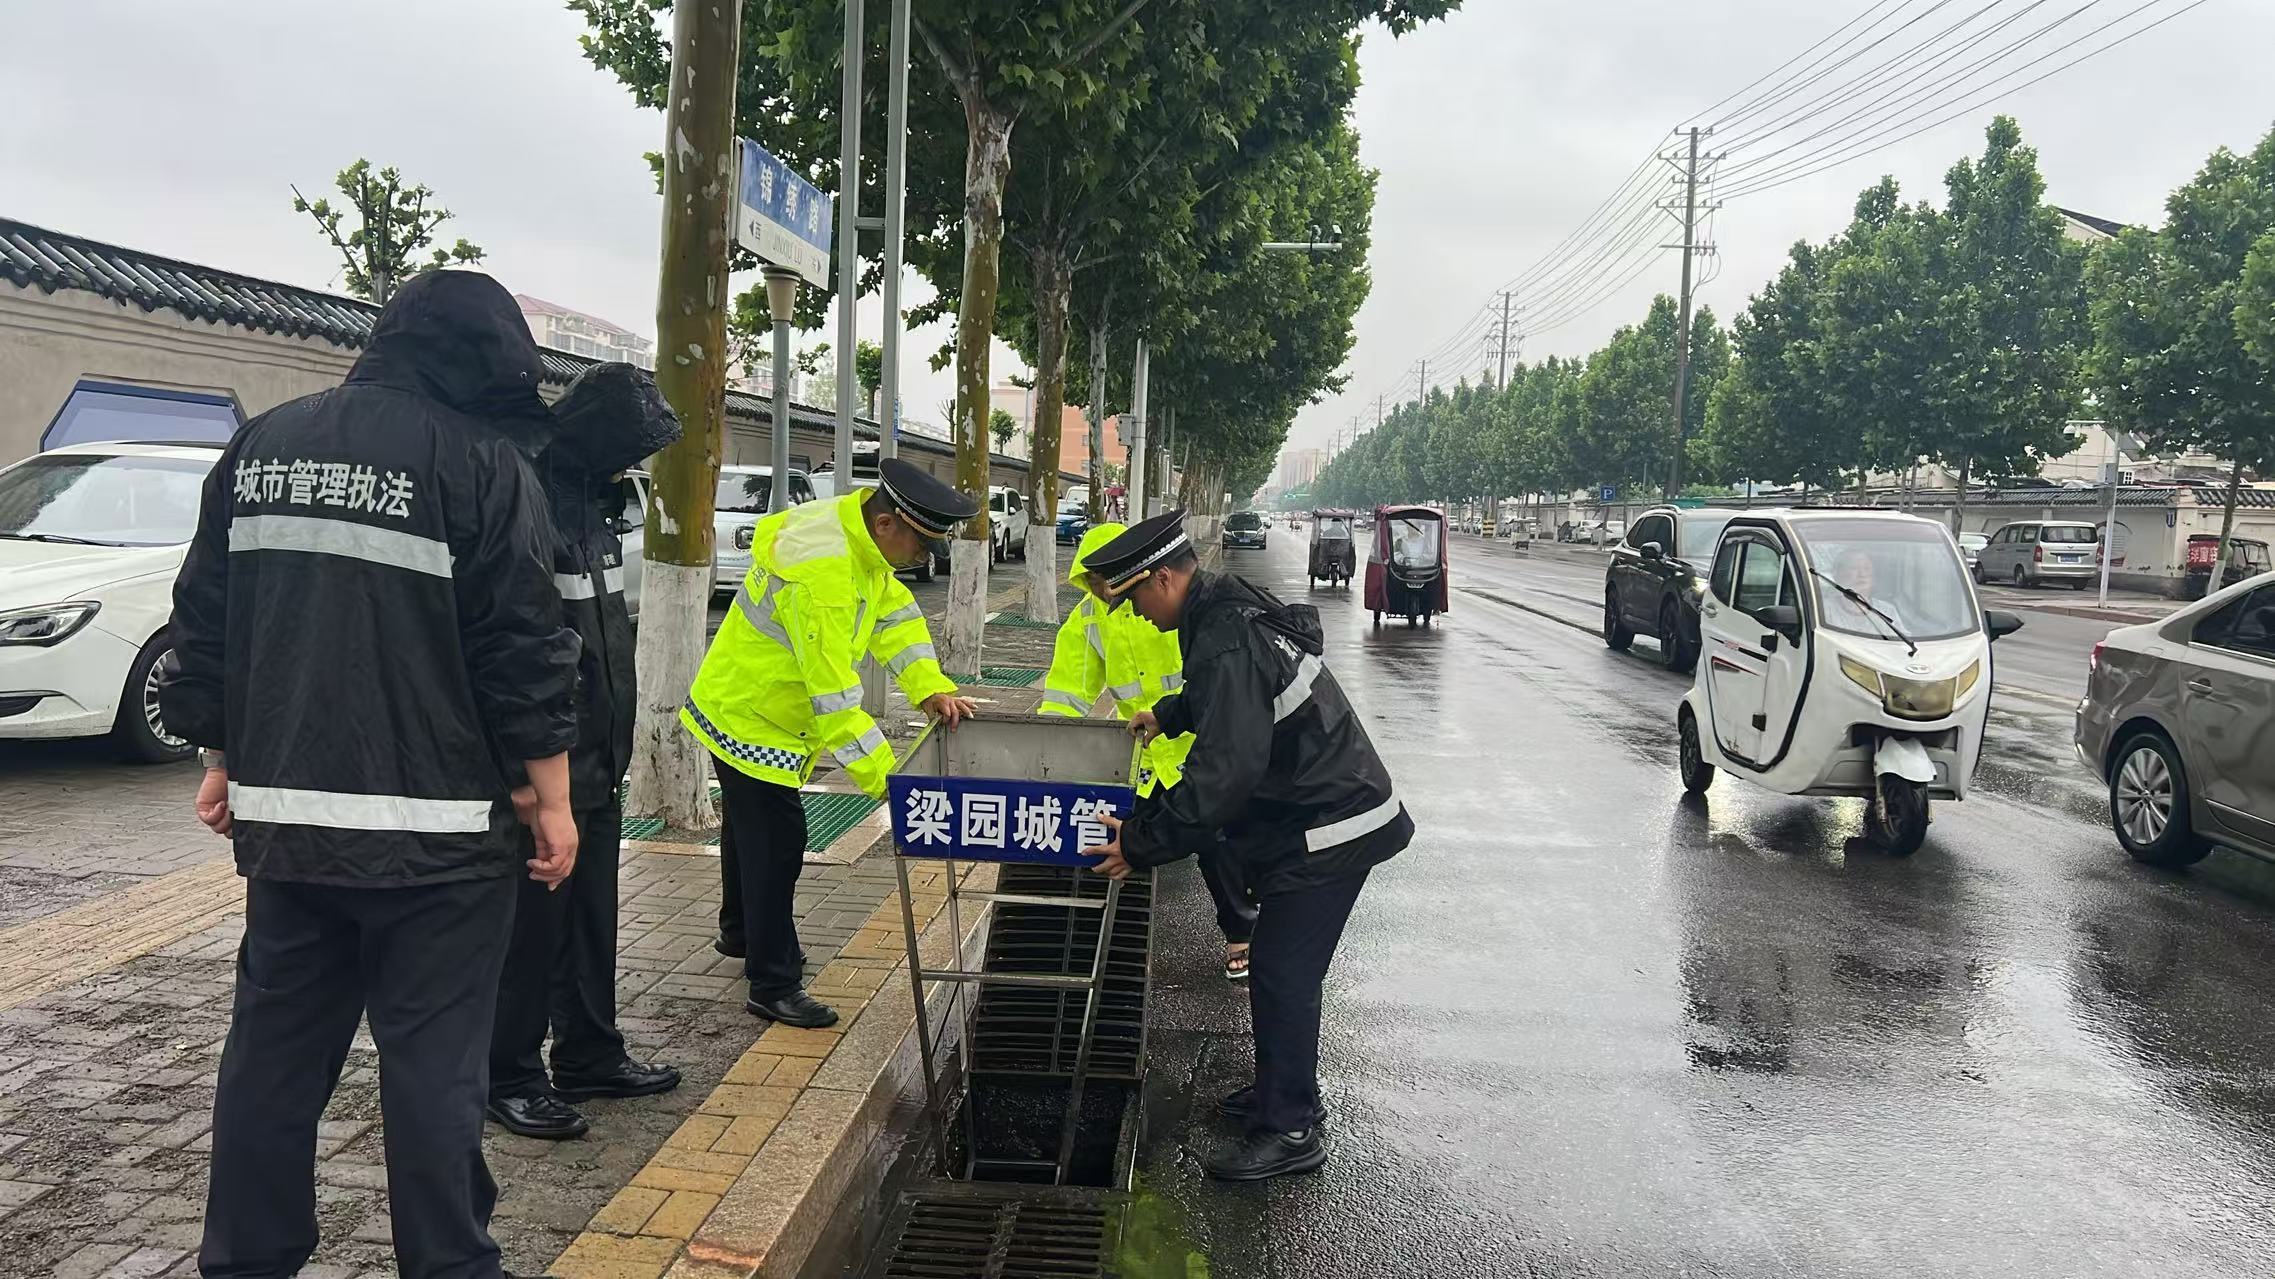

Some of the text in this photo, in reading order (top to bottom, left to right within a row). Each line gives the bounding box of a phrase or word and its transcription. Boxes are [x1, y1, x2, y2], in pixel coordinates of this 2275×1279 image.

[233, 458, 414, 519] 城市管理执法
[1603, 489, 1613, 499] P
[904, 787, 1117, 855] 梁园城管
